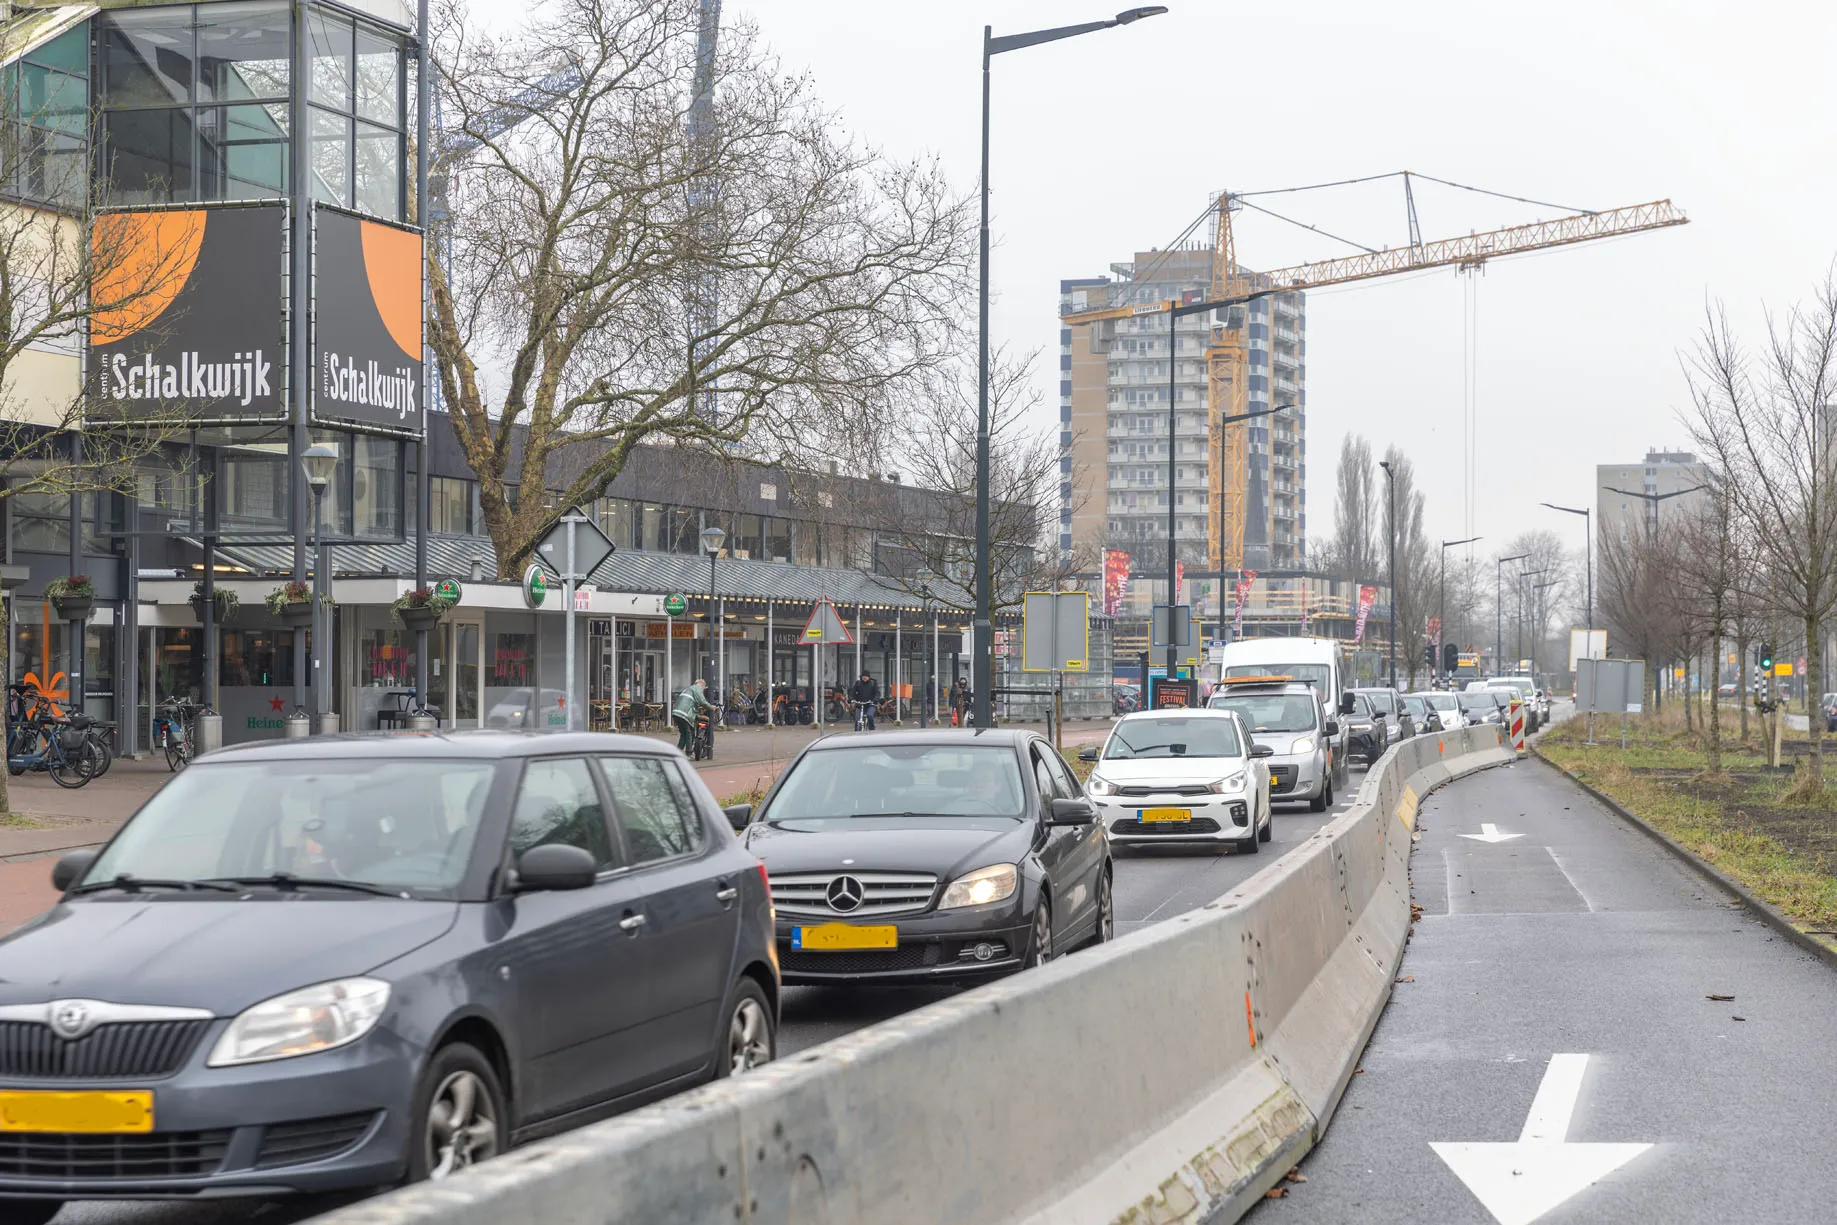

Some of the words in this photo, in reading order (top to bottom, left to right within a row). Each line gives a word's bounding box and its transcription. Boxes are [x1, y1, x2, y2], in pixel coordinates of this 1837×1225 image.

[112, 350, 271, 406] Schalkwijk
[330, 352, 415, 419] Schalkwijk
[247, 716, 284, 729] Heine
